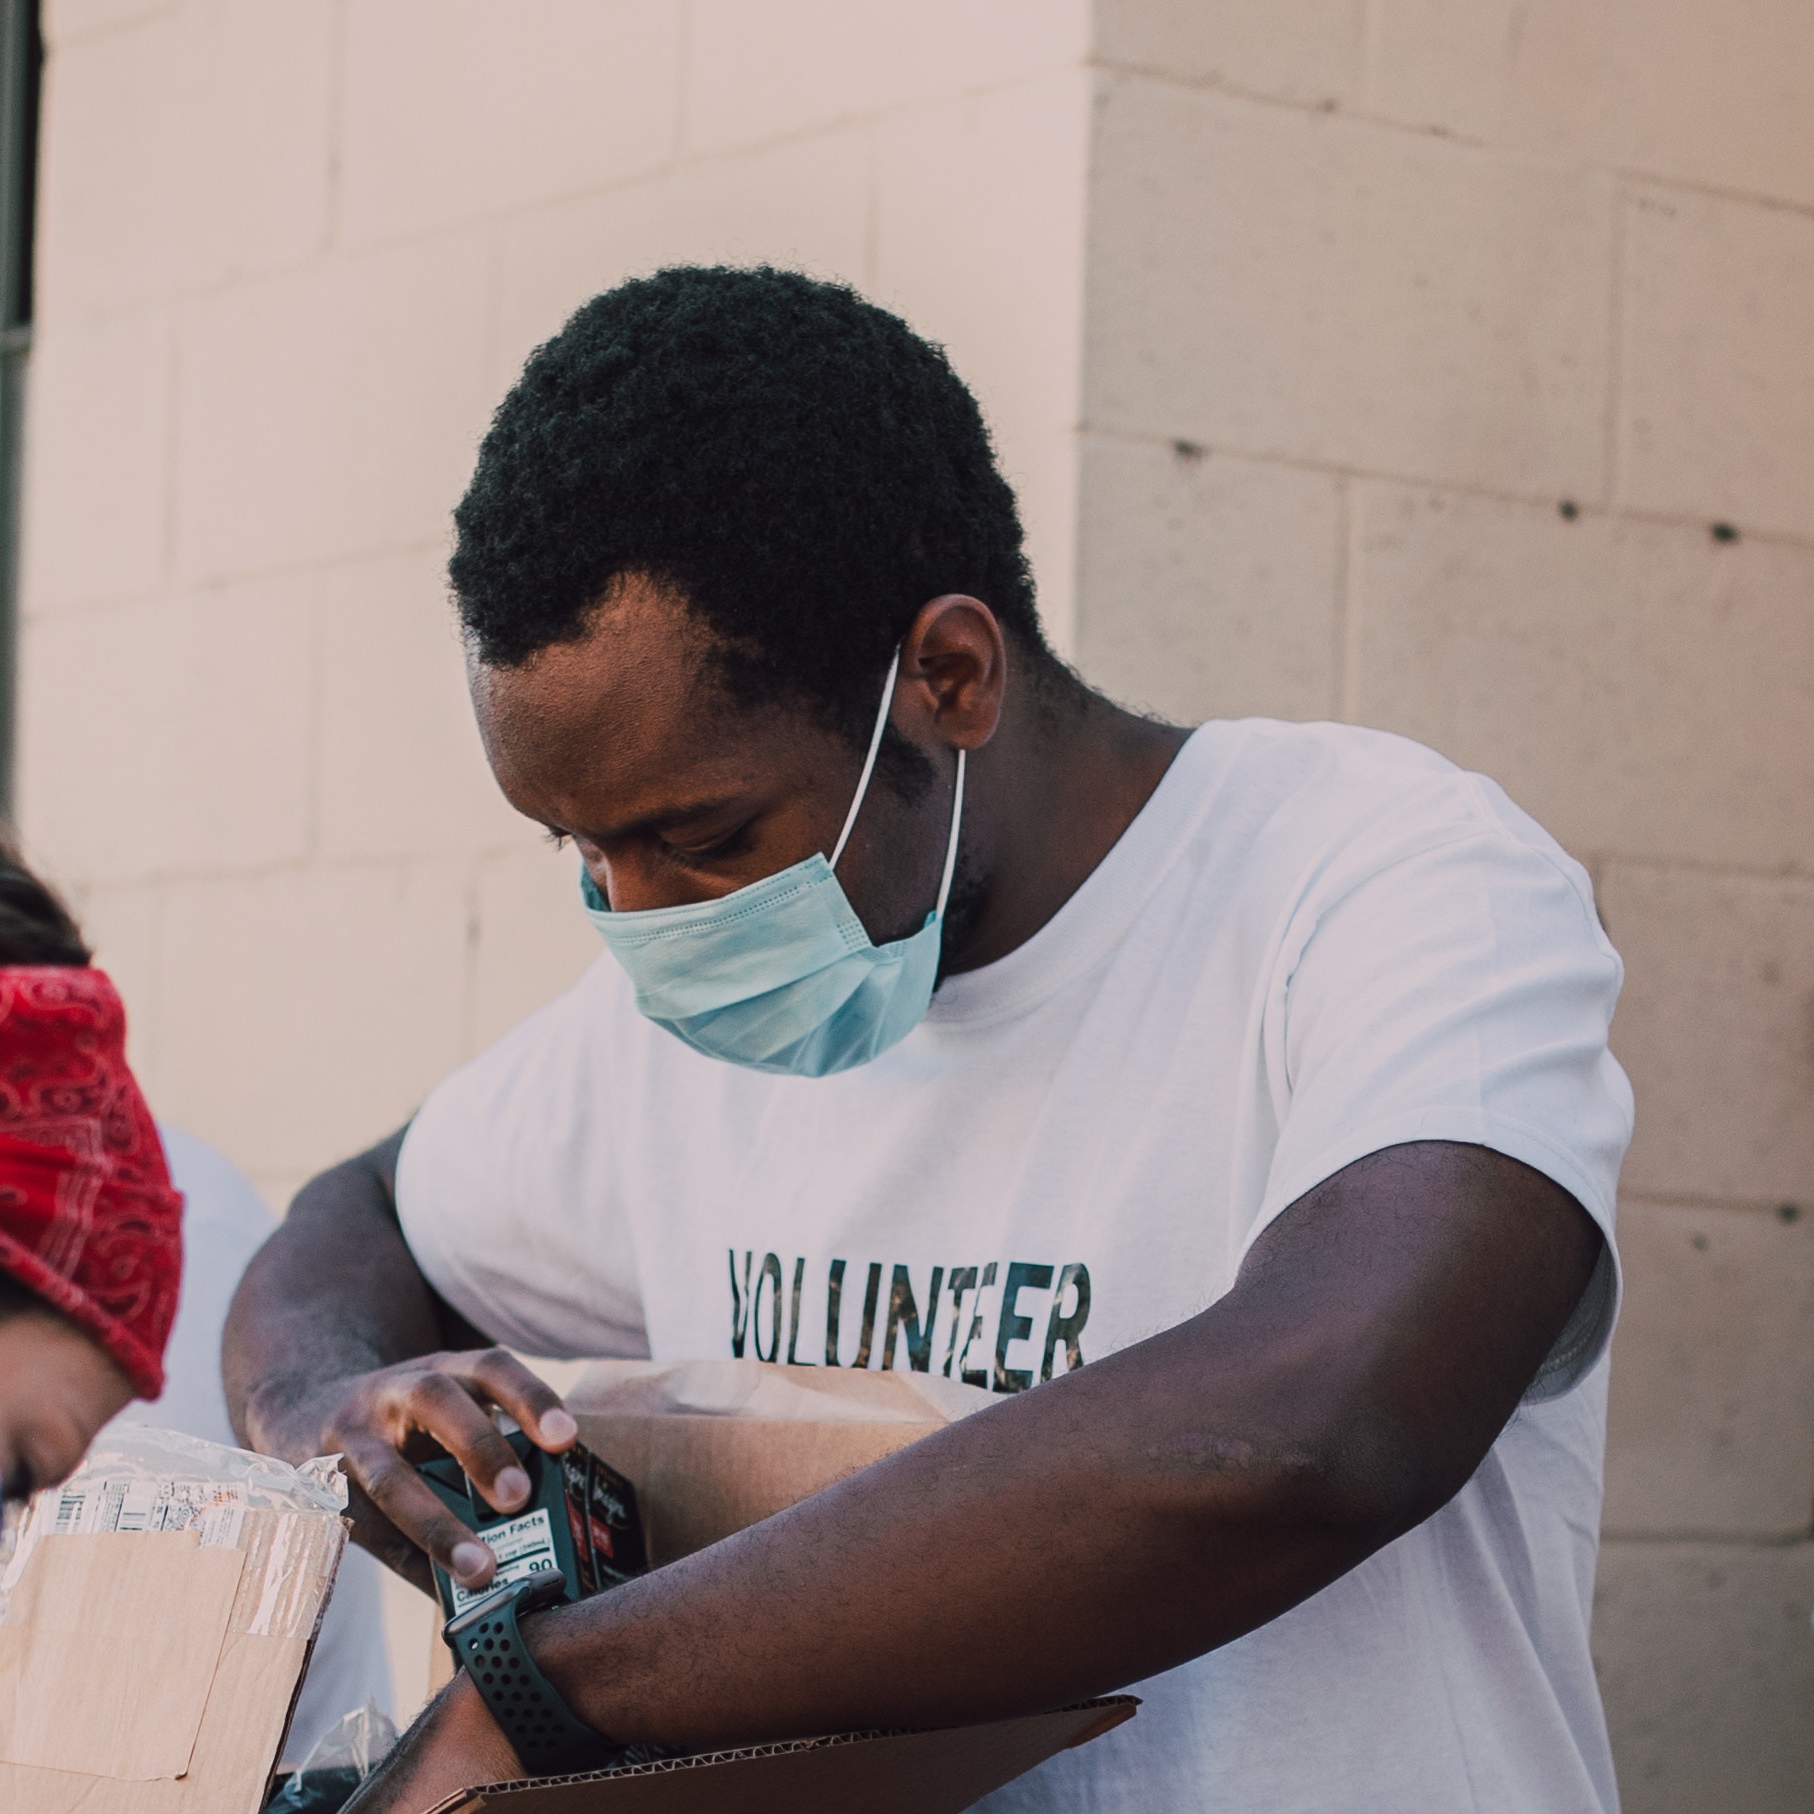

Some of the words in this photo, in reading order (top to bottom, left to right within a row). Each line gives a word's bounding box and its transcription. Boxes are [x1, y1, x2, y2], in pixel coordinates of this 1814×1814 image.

[728, 1248, 1091, 1394] VOLUNTEER
[510, 1516, 544, 1535] Facts
[529, 1558, 552, 1573] 90
